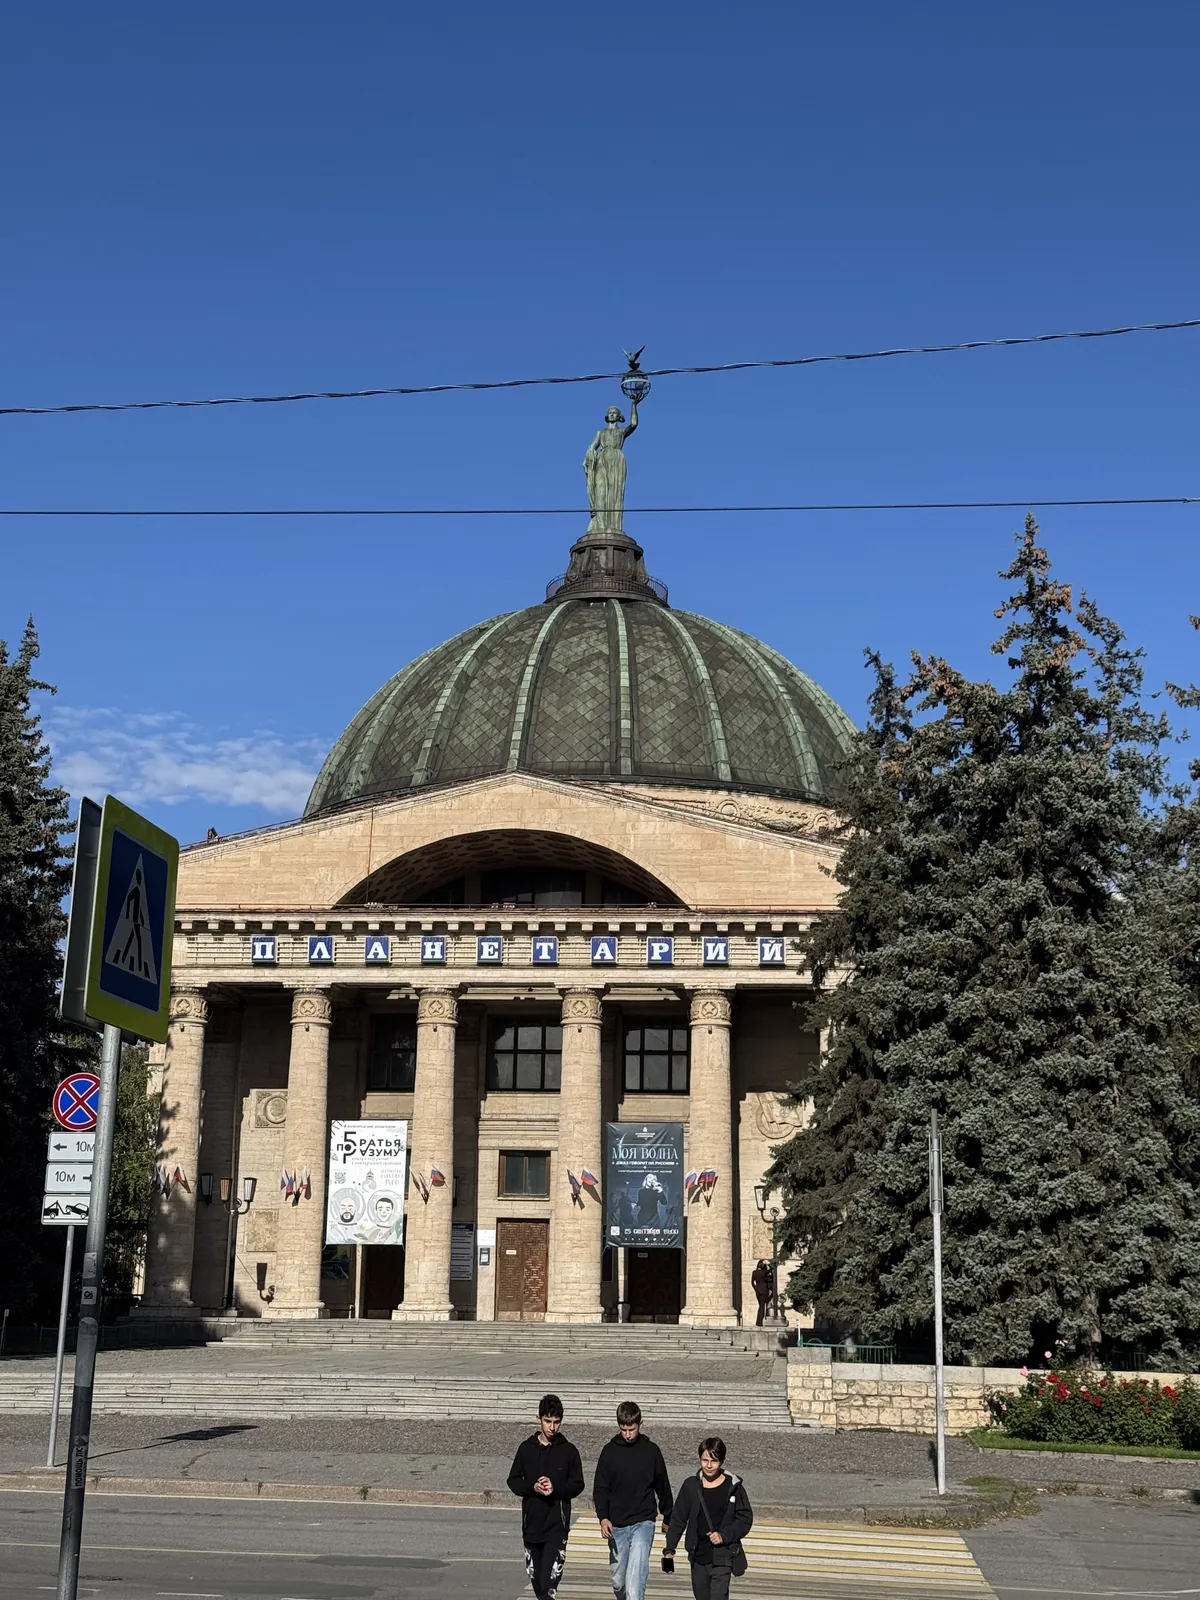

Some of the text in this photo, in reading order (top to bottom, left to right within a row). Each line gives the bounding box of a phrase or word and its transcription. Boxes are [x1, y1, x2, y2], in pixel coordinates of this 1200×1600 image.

[253, 940, 783, 961] ПЛАНЕТАРИЙ
[612, 1147, 679, 1160] МОЯ ВОЛНА
